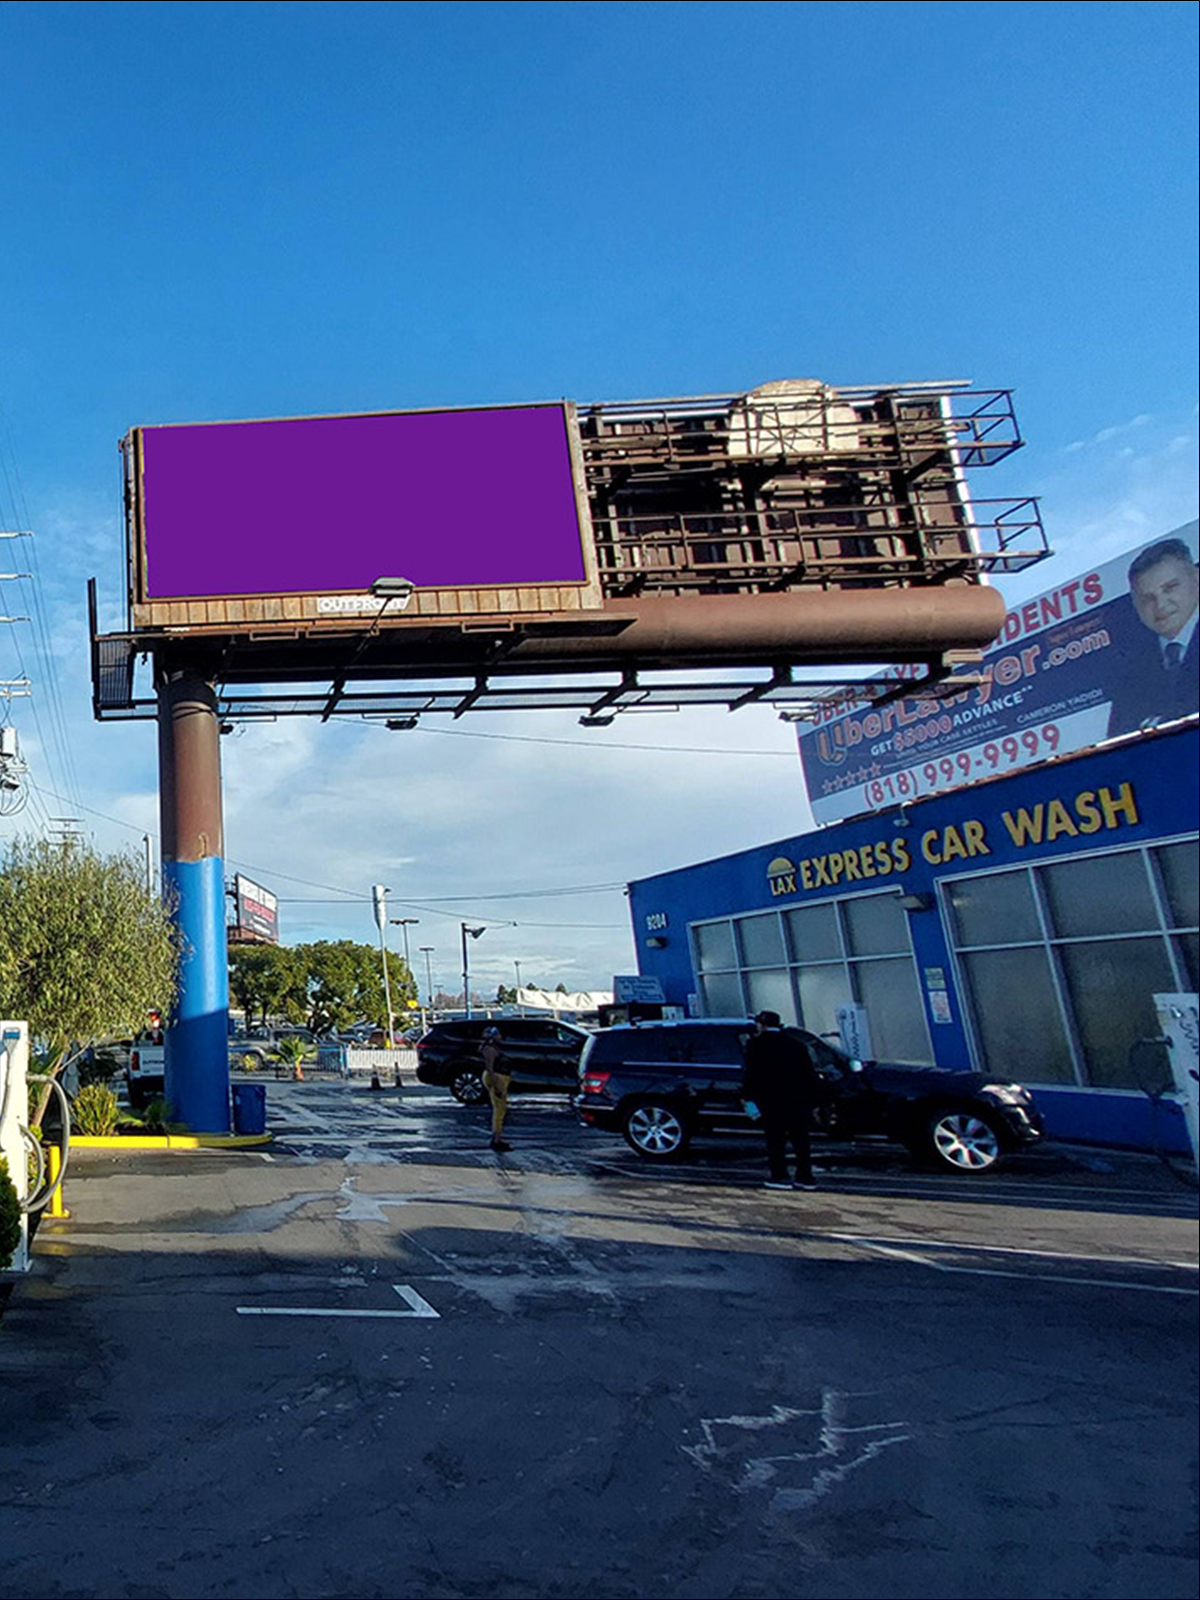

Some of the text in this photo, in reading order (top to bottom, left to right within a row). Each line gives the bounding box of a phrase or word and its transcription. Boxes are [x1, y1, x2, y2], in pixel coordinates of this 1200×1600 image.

[864, 769, 919, 808] (818)
[924, 724, 1060, 786] 999-9999
[871, 740, 893, 756] GET
[893, 715, 953, 751] $5000
[769, 782, 1139, 896] LAX EXPRESS CAR WASH
